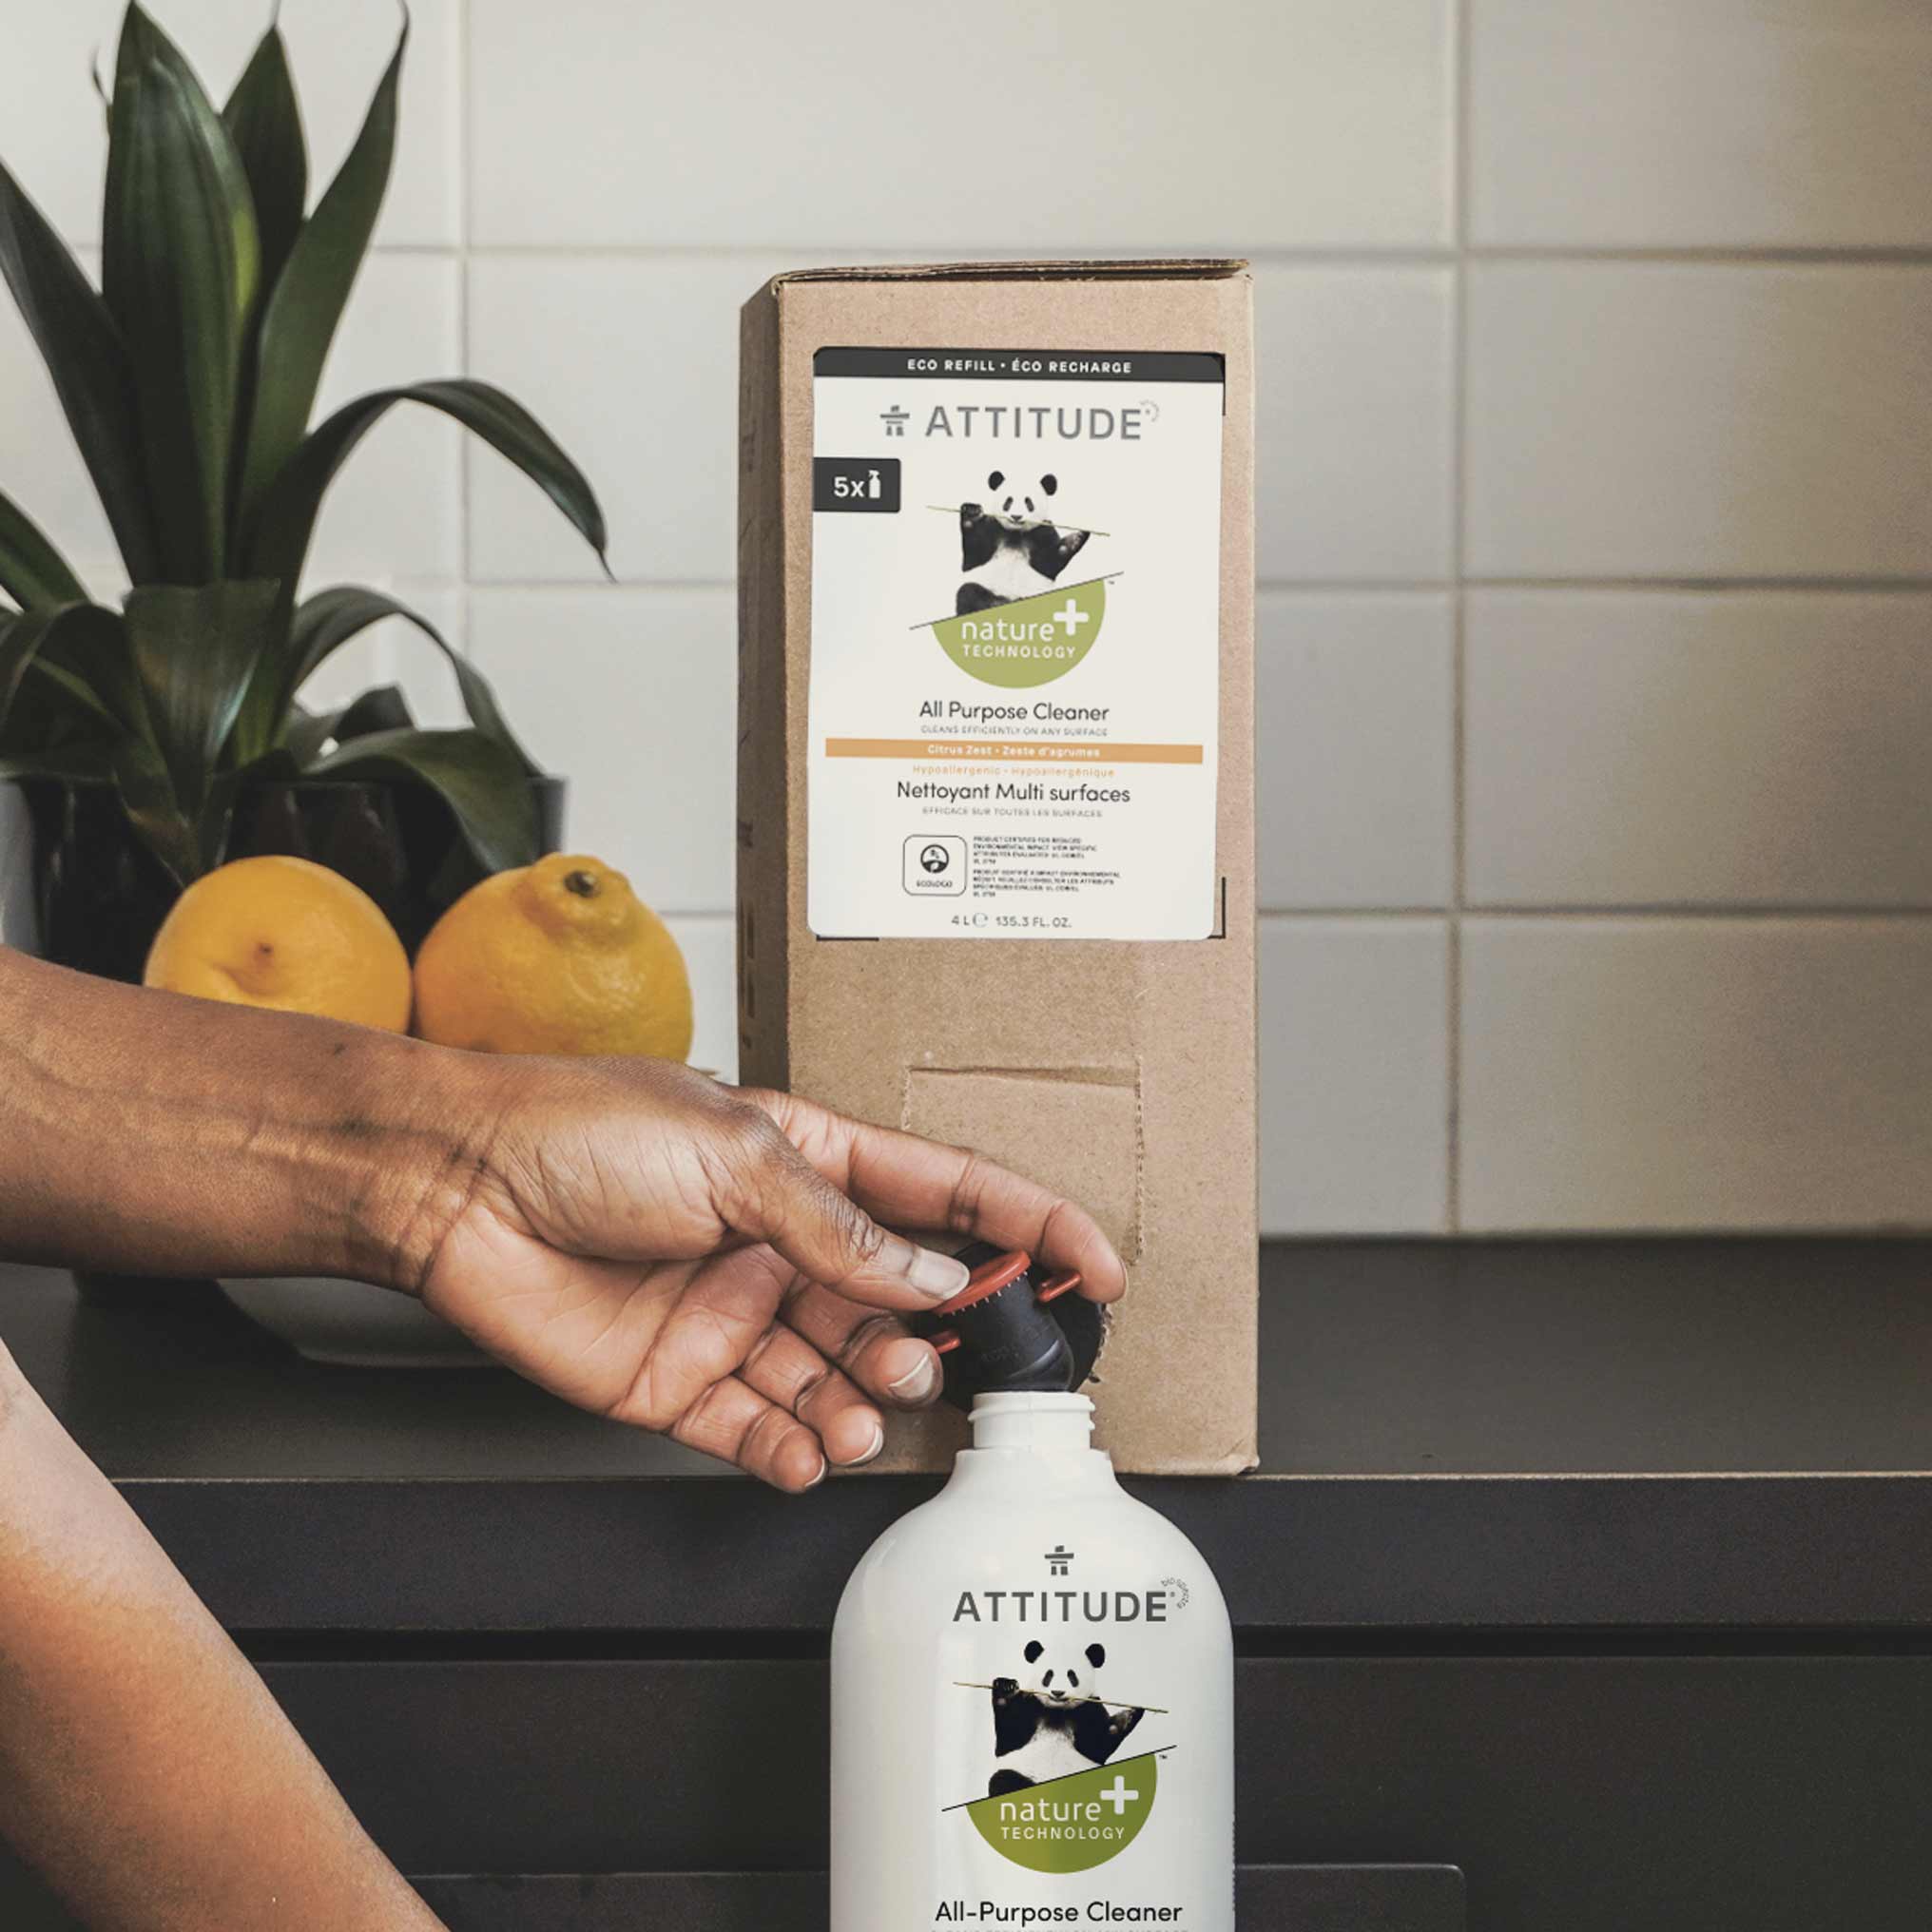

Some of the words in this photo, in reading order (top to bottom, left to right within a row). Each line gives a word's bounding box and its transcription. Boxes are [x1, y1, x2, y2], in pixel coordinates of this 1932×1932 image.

[907, 358, 938, 372] ECO
[944, 359, 995, 372] REFILL
[1012, 357, 1043, 373] ÉCO
[1049, 360, 1132, 375] RECHARGE
[925, 405, 1142, 440] ATTITUDE
[833, 475, 864, 498] 5x
[963, 644, 1076, 659] TECHNOLOGY
[918, 700, 943, 718] All
[949, 701, 1028, 723] Purpose
[1033, 702, 1110, 722] Cleaner
[920, 724, 958, 734] CLEANS
[962, 725, 1020, 735] EFFICIENTLY
[1023, 726, 1038, 736] ON
[1040, 726, 1061, 736] ANY
[1063, 727, 1108, 737] SURFACE
[927, 744, 963, 755] Citrus
[966, 745, 993, 756] Zest
[1002, 745, 1035, 757] Zeste
[1038, 746, 1100, 759] d'agrumes
[913, 764, 1001, 777] Hypoallergenic
[898, 781, 990, 803] Nettoyant
[995, 782, 1044, 801] Multi
[1050, 783, 1130, 802] surfaces
[922, 807, 968, 816] EFFICACE
[972, 807, 991, 816] SUR
[994, 807, 1030, 817] TOUTES
[1033, 808, 1049, 817] LES
[1052, 809, 1102, 819] SURFACES
[951, 915, 959, 926] 4
[963, 916, 971, 926] L
[995, 916, 1030, 928] 135.3
[953, 1591, 1167, 1622] ATTITUDE
[1000, 1826, 1125, 1840] TECHNOLOGY
[935, 1901, 1079, 1927] All-Purpose
[1087, 1901, 1183, 1922] Cleaner
